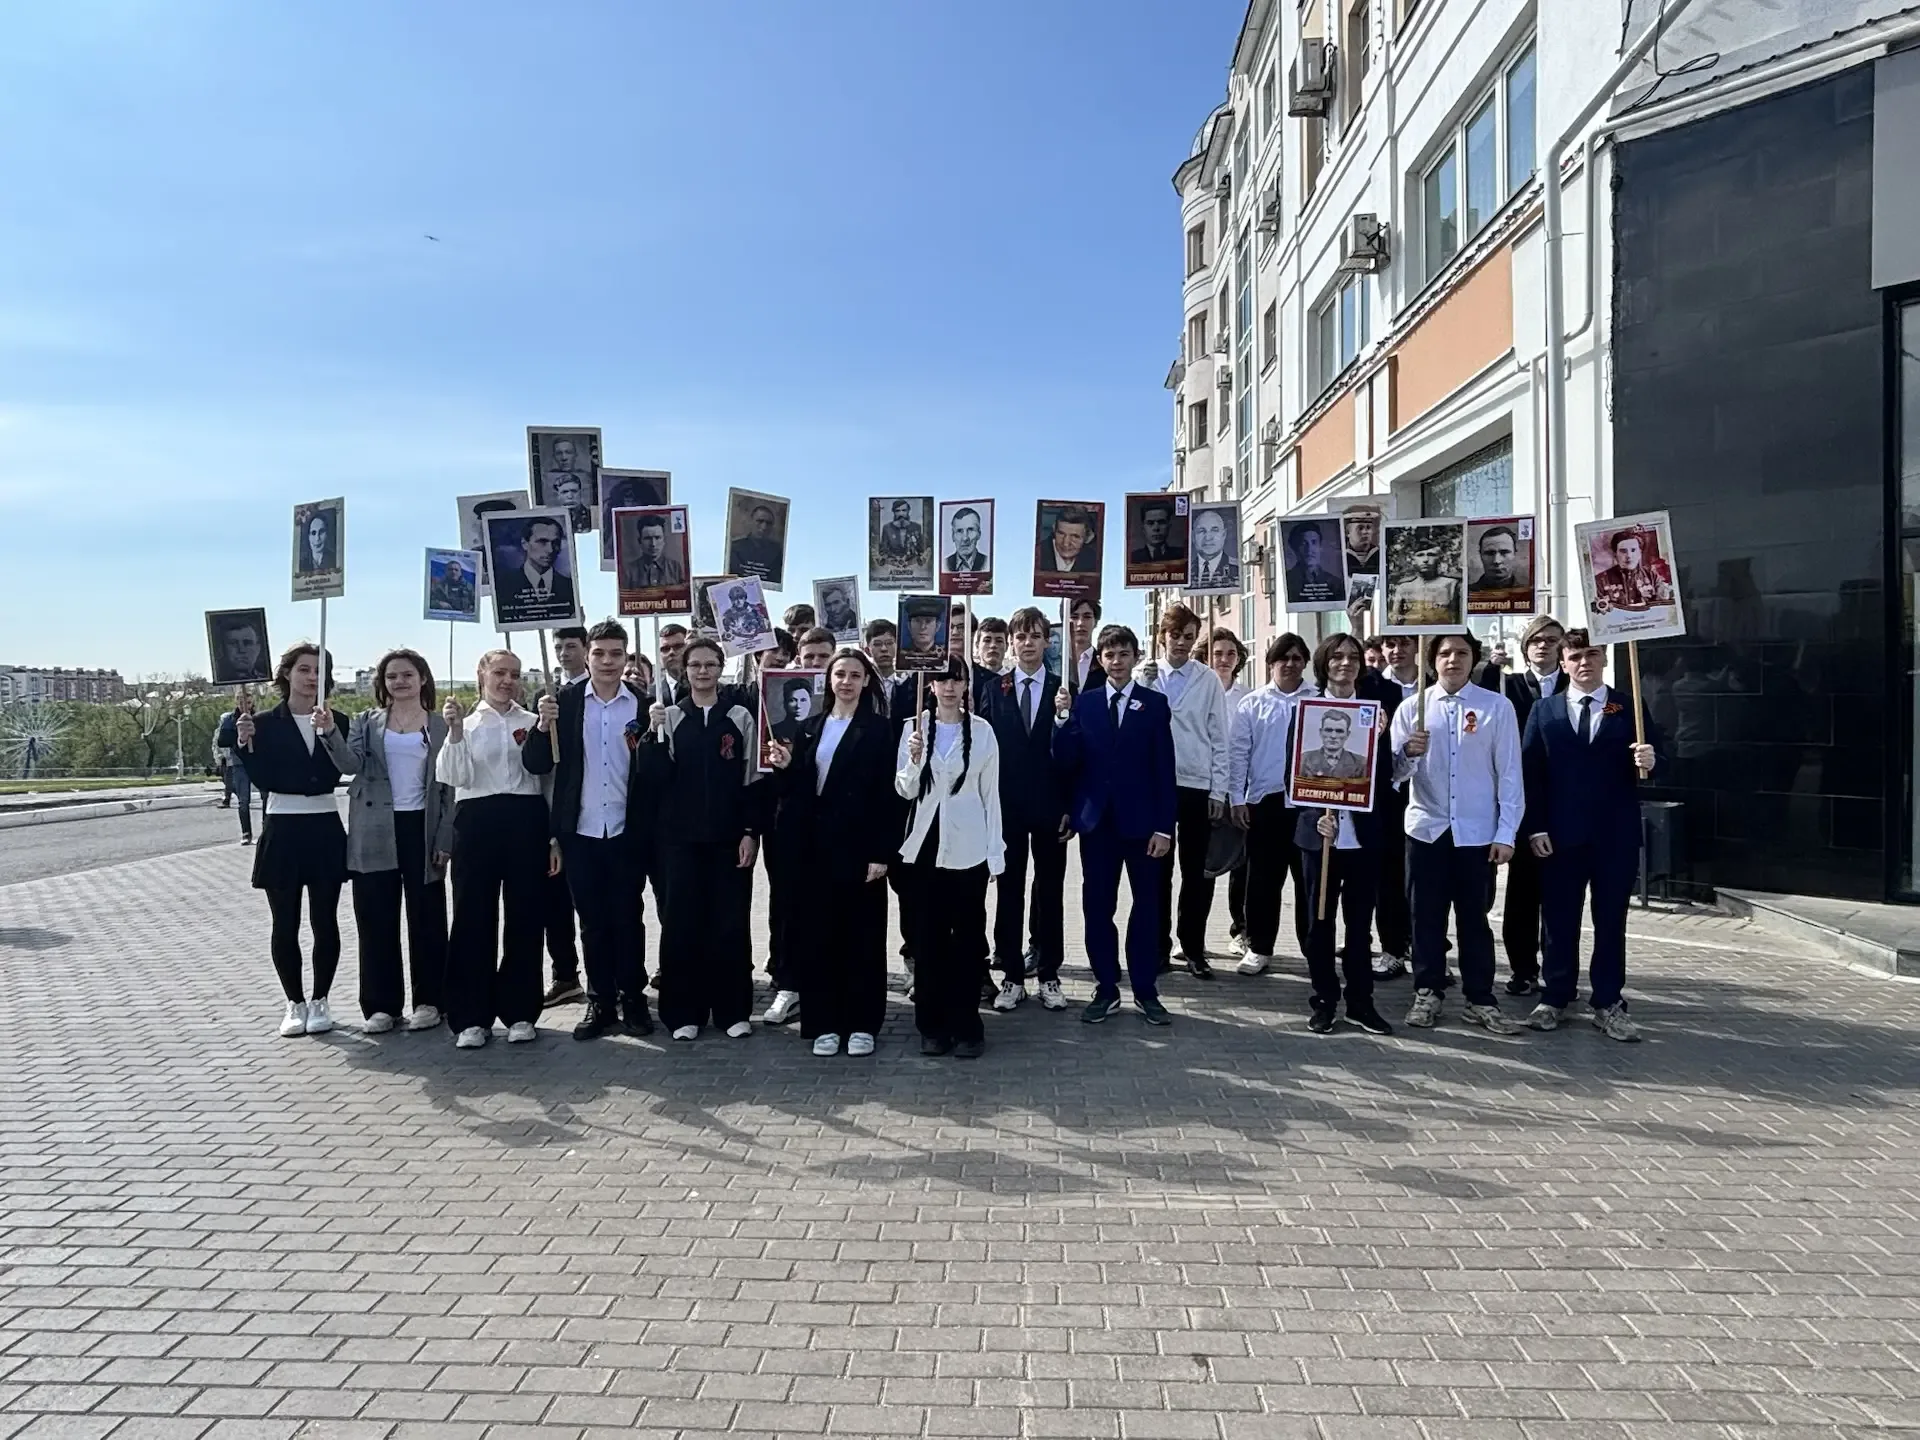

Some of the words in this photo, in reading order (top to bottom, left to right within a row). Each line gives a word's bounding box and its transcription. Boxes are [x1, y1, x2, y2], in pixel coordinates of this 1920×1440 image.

[624, 599, 668, 610] БЕССМЕРТНЫЙ
[1297, 788, 1344, 801] БЕССМЕРТНЫЙ
[1347, 793, 1365, 803] ПОЛК
